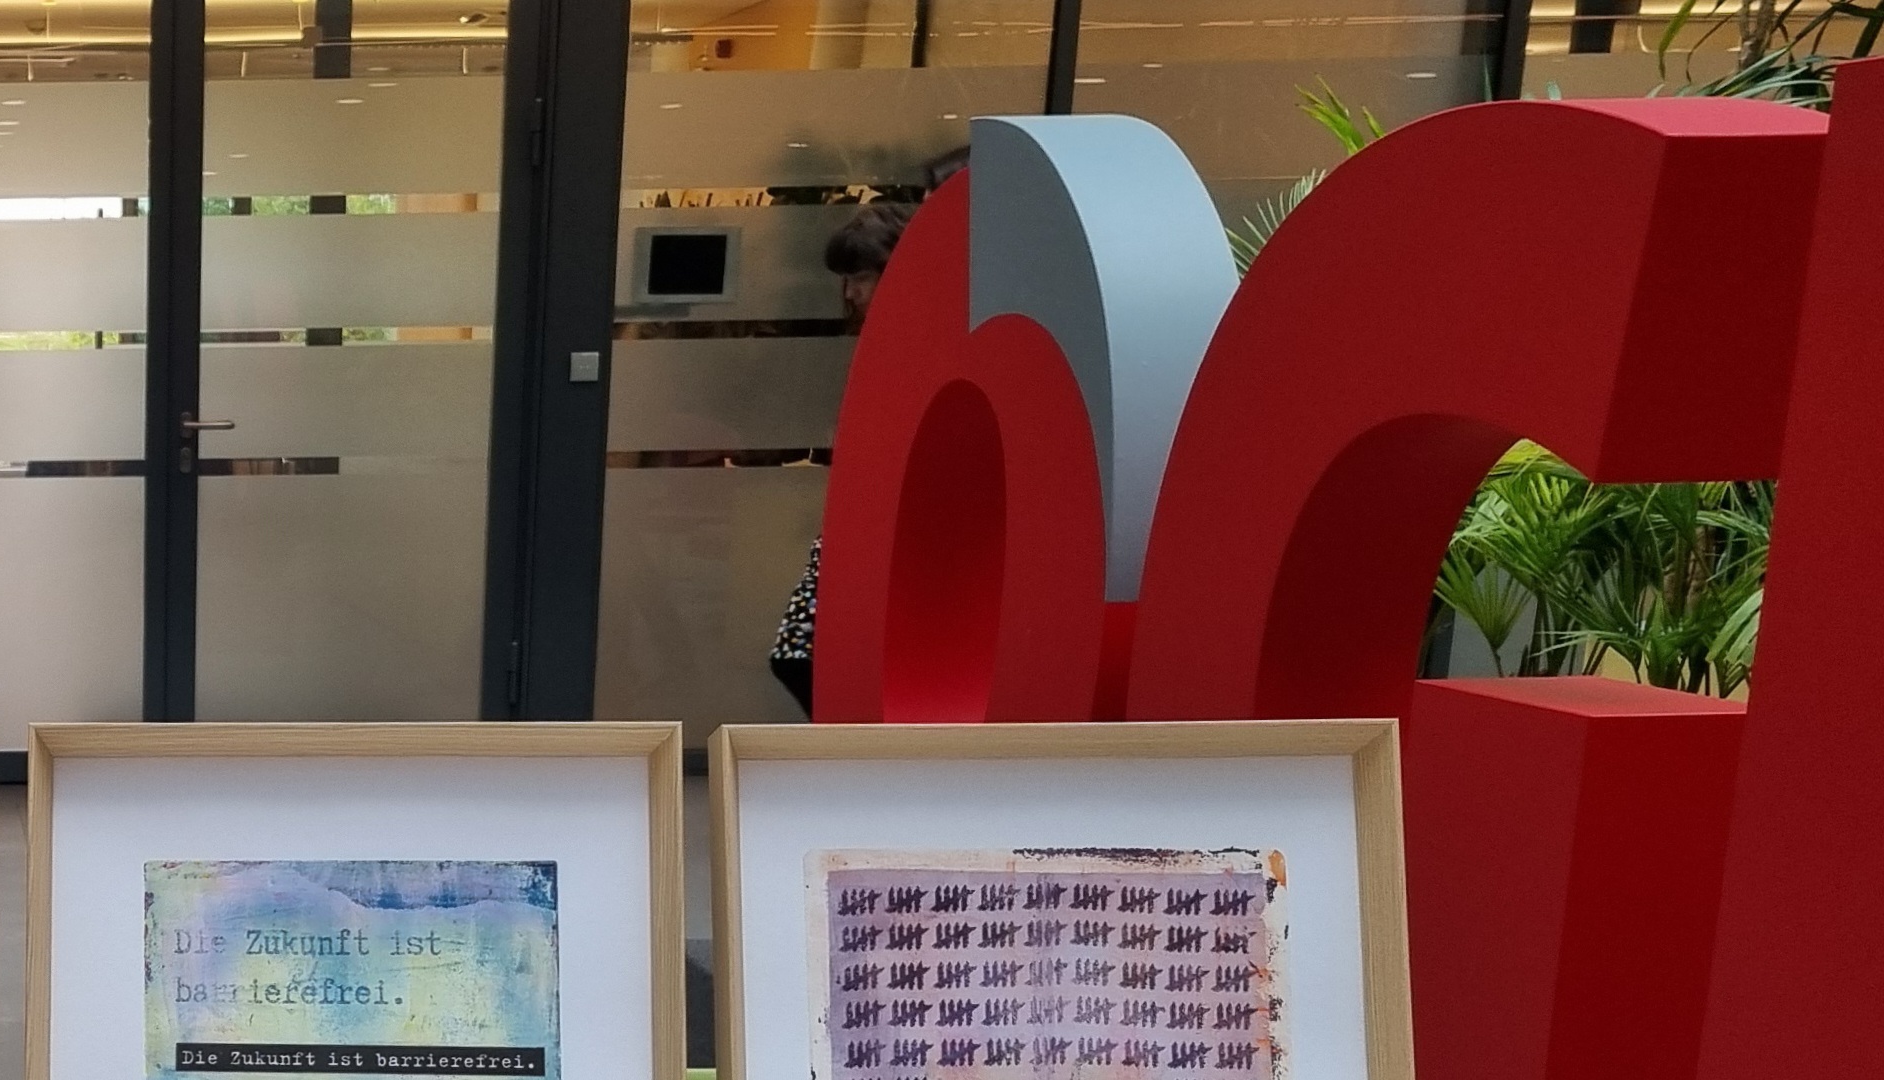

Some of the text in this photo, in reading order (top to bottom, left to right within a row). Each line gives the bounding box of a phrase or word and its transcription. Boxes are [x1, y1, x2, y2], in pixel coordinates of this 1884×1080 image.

[174, 929, 442, 957] Die Zukunft ist
[181, 1049, 536, 1070] Die Zukunft ist barrierefrei.
